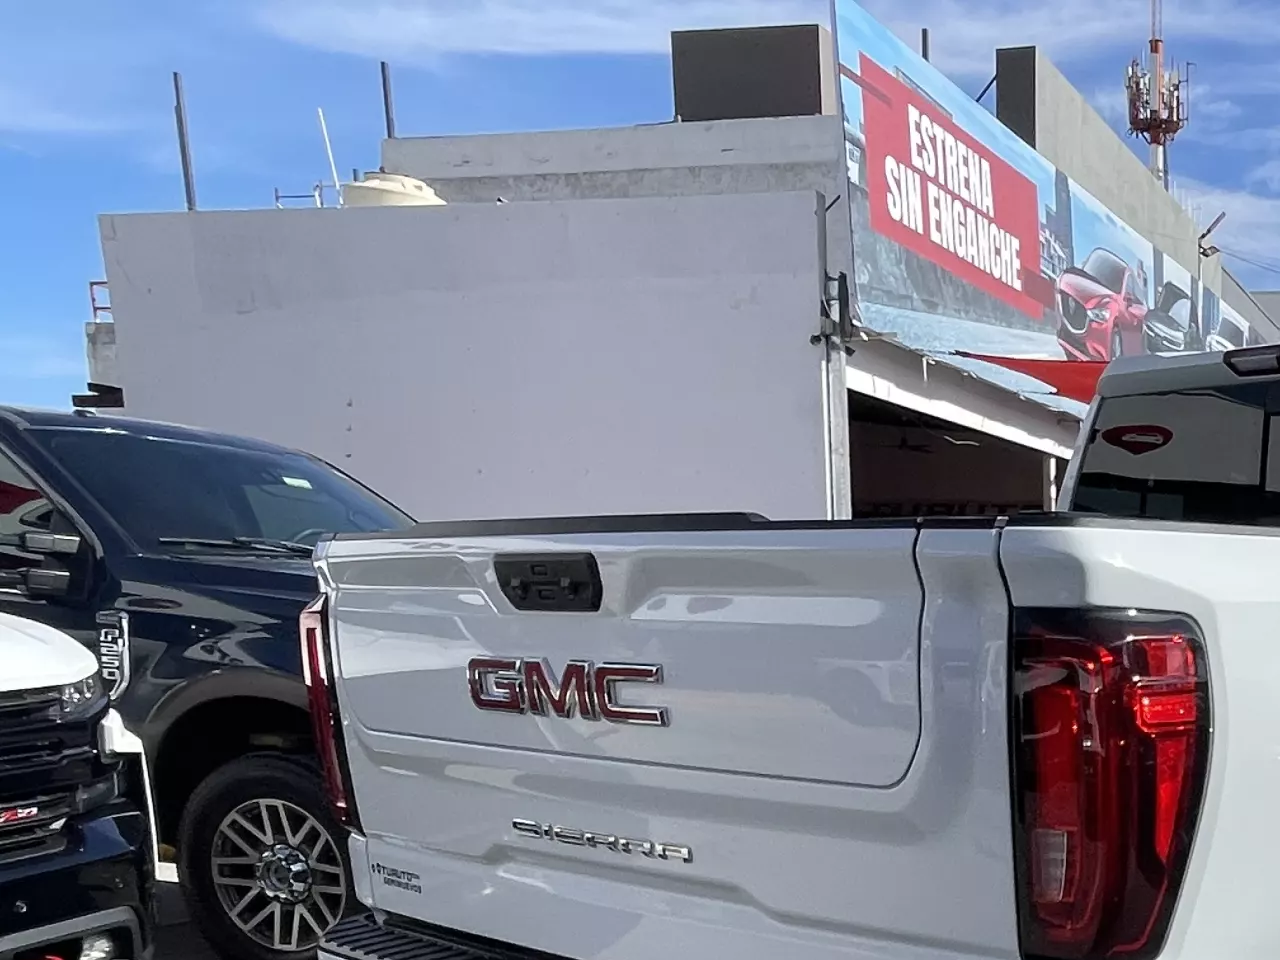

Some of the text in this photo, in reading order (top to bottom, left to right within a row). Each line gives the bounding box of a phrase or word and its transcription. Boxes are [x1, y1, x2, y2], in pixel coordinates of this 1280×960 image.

[907, 103, 994, 218] ESTRENA
[884, 155, 1022, 291] SIN ENGANCHE
[467, 655, 671, 727] GMC
[512, 817, 693, 863] SIERRA
